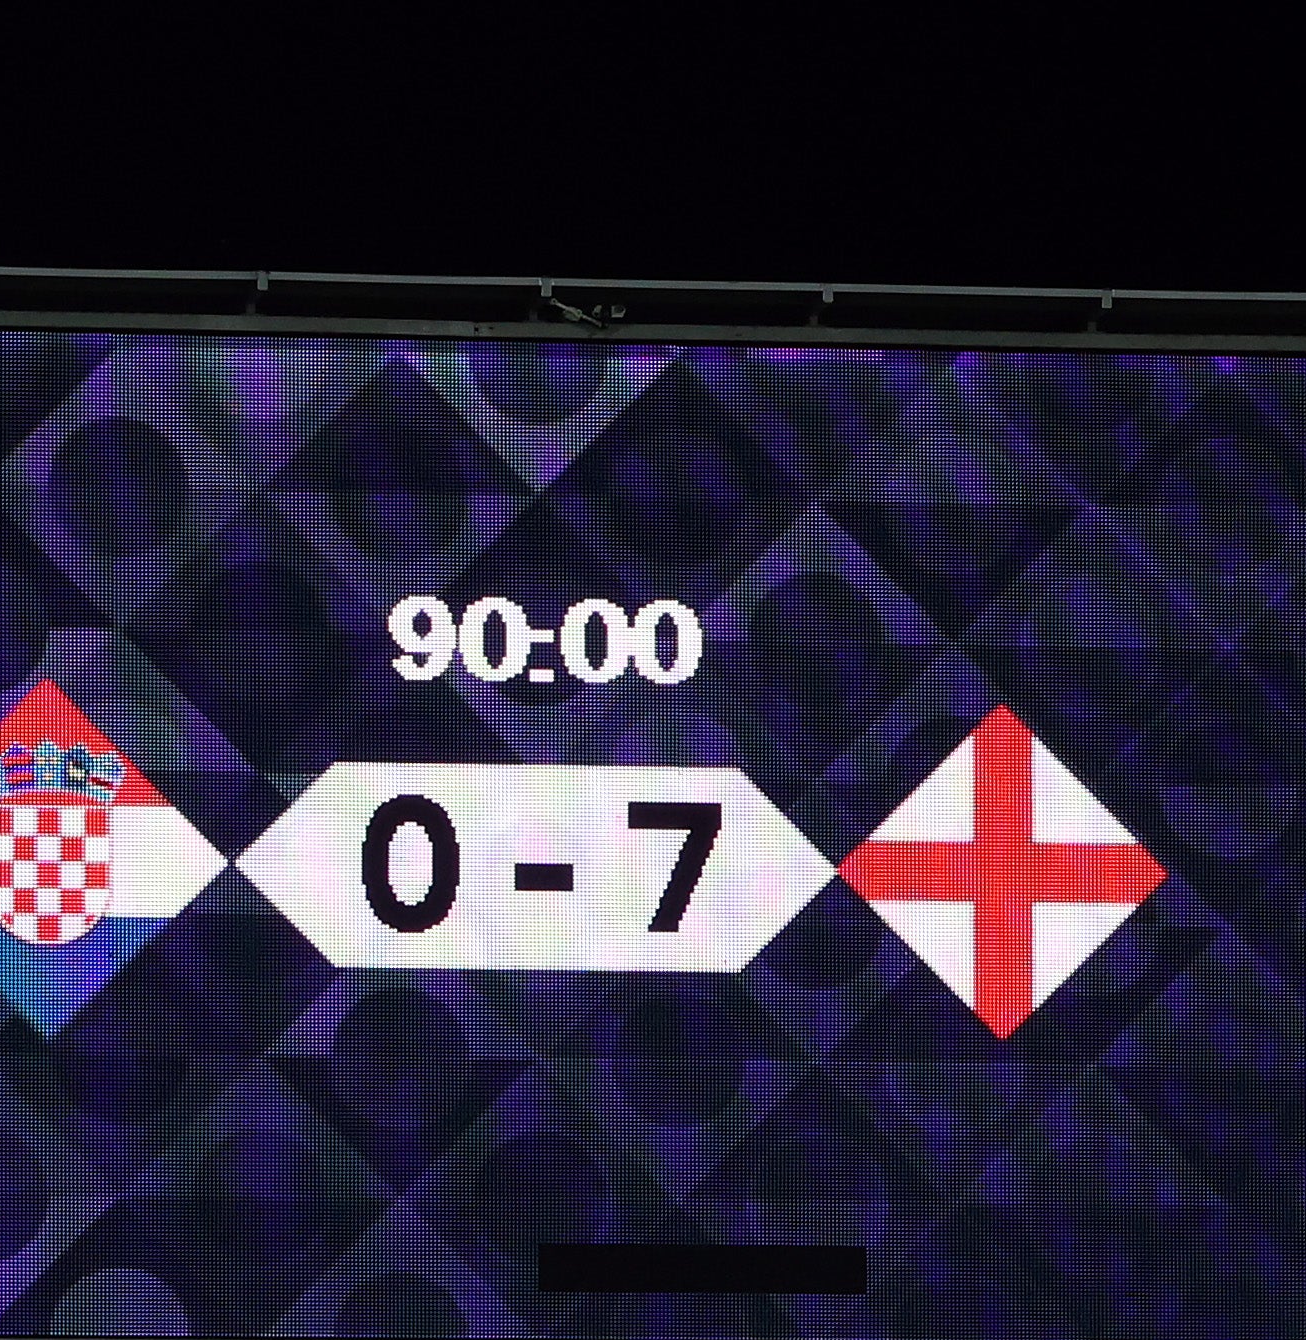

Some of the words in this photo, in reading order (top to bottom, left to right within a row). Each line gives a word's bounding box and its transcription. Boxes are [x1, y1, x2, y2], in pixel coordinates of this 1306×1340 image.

[388, 595, 703, 685] 90:00
[361, 794, 460, 934] 0
[628, 802, 722, 933] 7
